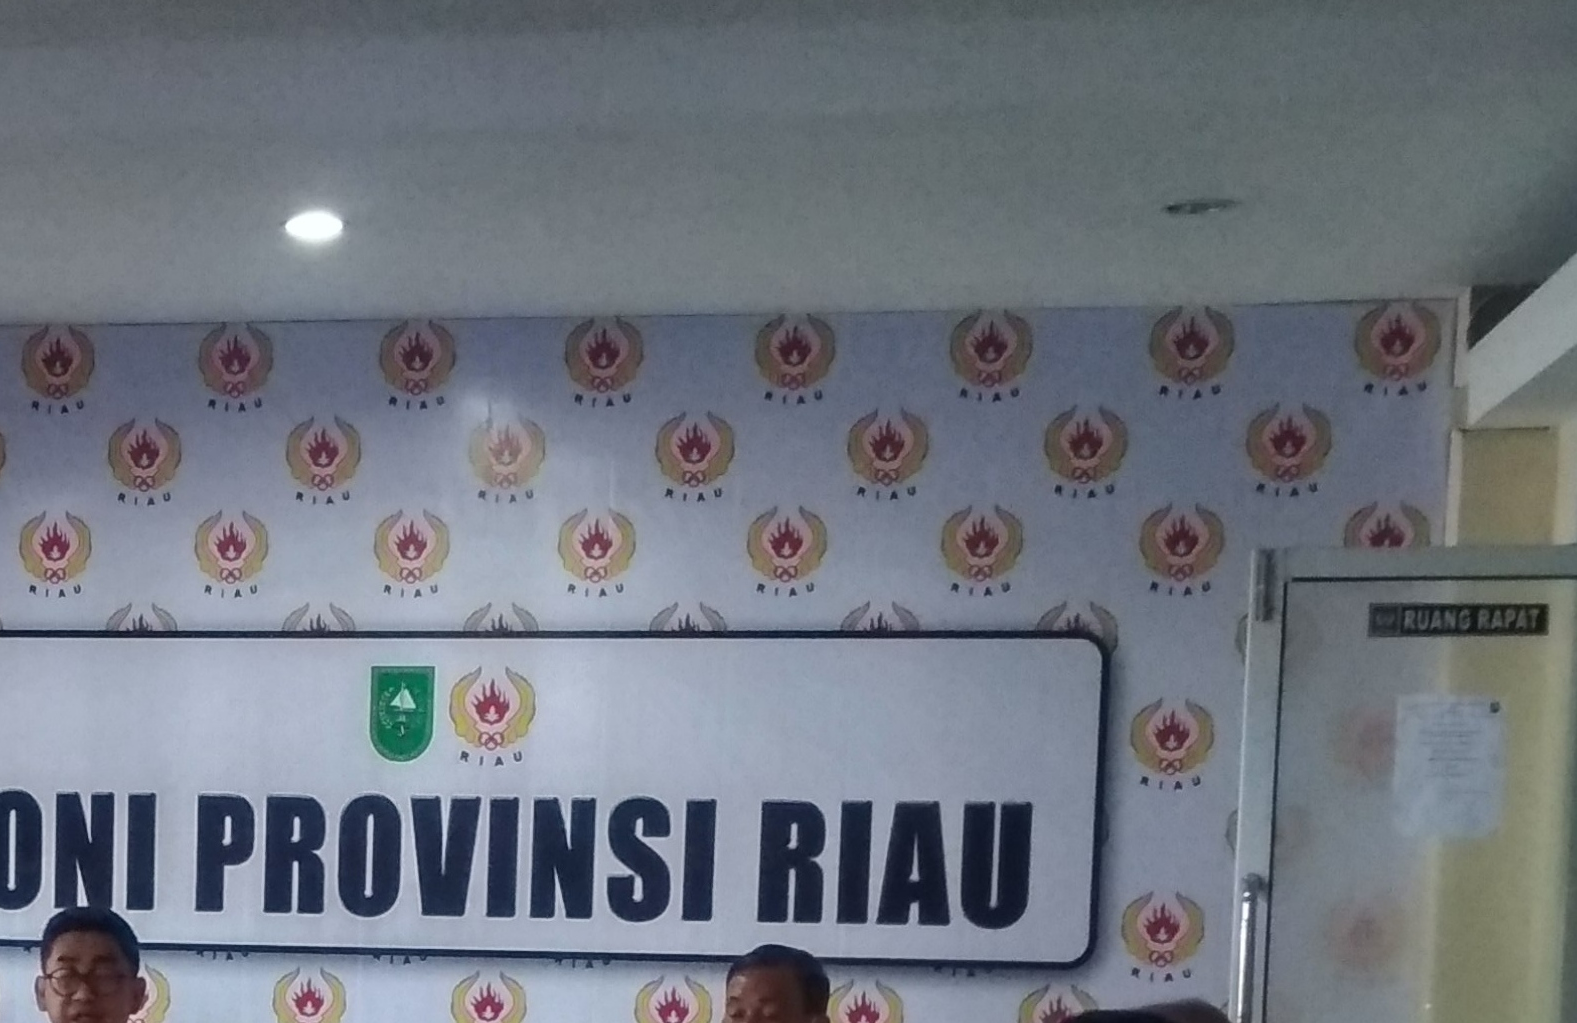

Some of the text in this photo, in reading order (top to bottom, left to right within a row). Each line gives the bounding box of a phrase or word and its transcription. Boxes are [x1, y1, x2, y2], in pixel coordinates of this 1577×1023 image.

[958, 387, 1020, 404] RIAU
[1158, 384, 1222, 401] RIAU
[1363, 380, 1428, 397] RIAU
[388, 395, 445, 411] RIAU
[574, 392, 632, 408] RIAU
[763, 389, 824, 405] RIAU
[31, 399, 85, 415] RIAU
[207, 397, 263, 414] RIAU
[295, 490, 351, 506] RIAU
[477, 489, 534, 504] RIAU
[664, 487, 723, 503] RIAU
[856, 485, 917, 501] RIAU
[1053, 483, 1116, 500] RIAU
[1255, 482, 1319, 498] RIAU
[117, 491, 172, 507] RIAU
[28, 584, 82, 599] RIAU
[203, 584, 258, 599] RIAU
[383, 584, 439, 599] RIAU
[567, 583, 625, 598] RIAU
[755, 582, 815, 598] RIAU
[950, 581, 1011, 598] RIAU
[1149, 580, 1212, 598] RIAU
[1403, 608, 1540, 631] RUANG RAPAT
[459, 750, 523, 767] RIAU
[1139, 775, 1202, 791] RIAU
[195, 792, 717, 922] PROVINSI
[757, 800, 1033, 929] RIAU
[1130, 966, 1192, 983] RIAU
